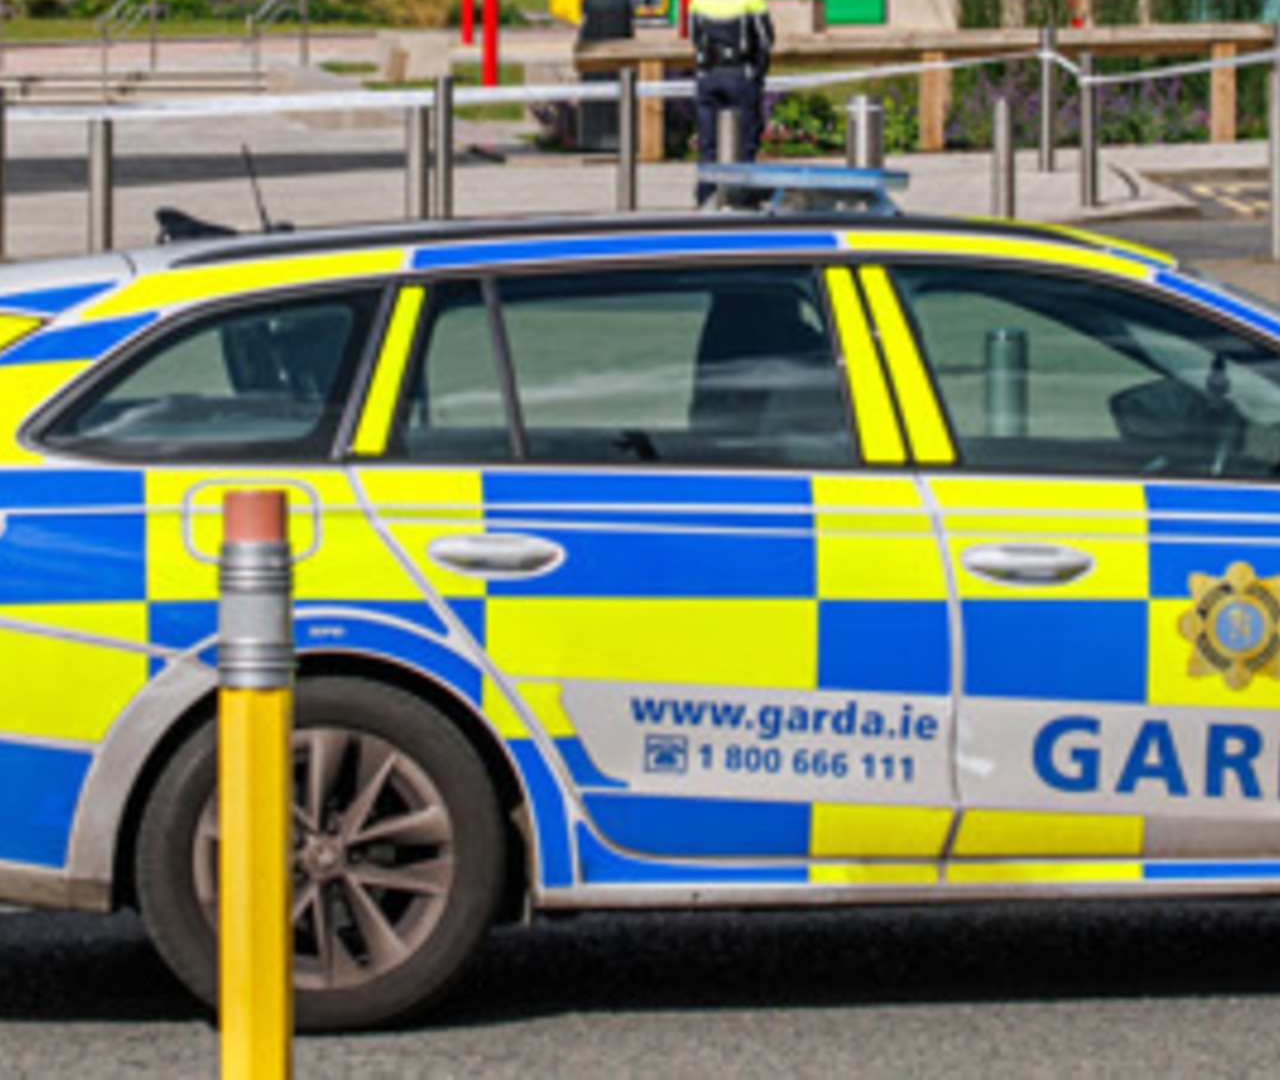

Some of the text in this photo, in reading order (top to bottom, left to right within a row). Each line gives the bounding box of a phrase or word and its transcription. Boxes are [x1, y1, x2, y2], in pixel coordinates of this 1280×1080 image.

[630, 696, 940, 740] www.garda.ie
[698, 742, 915, 782] 1 800 666 111
